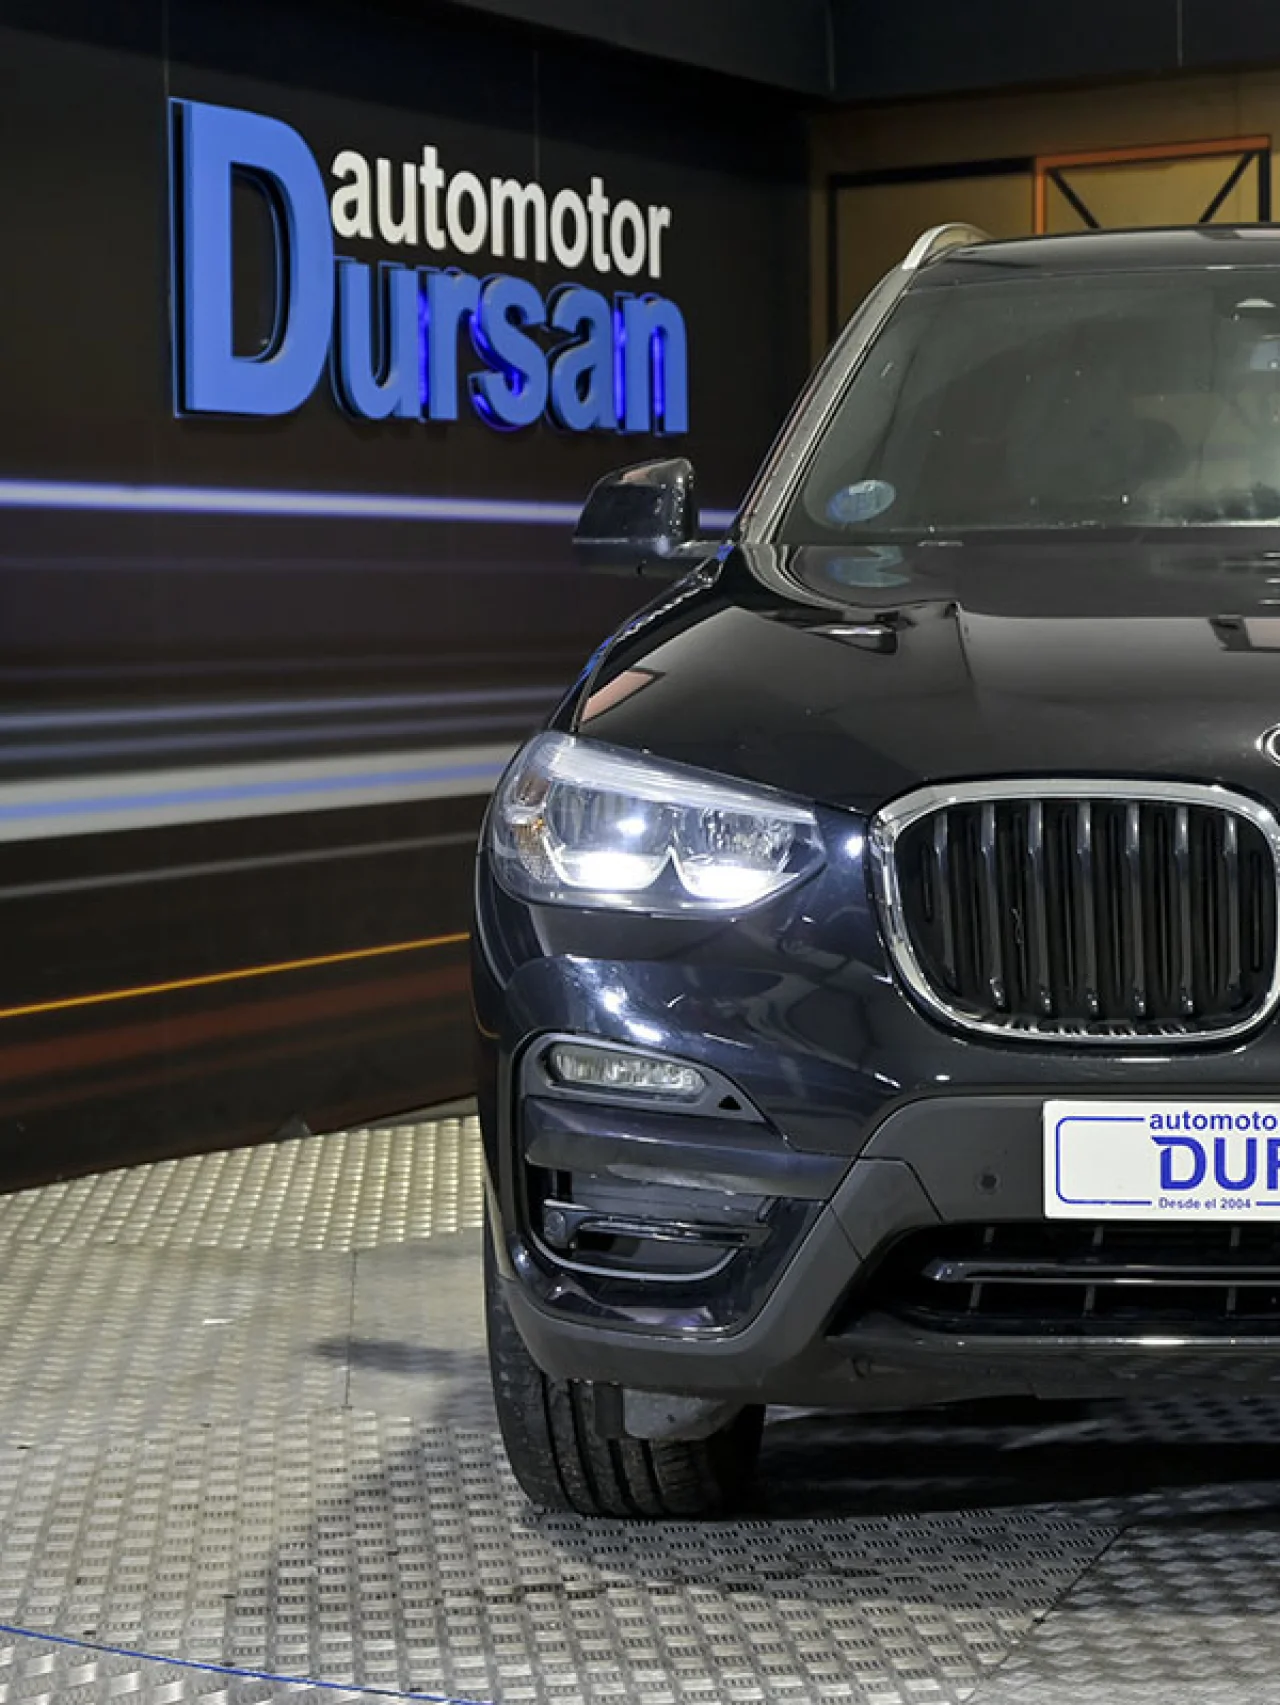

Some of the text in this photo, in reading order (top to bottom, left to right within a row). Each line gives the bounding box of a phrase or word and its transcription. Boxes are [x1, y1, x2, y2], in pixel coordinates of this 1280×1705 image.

[168, 97, 688, 436] Dursan
[330, 146, 671, 278] automotor
[1158, 1197, 1251, 1209] Desde el 2004
